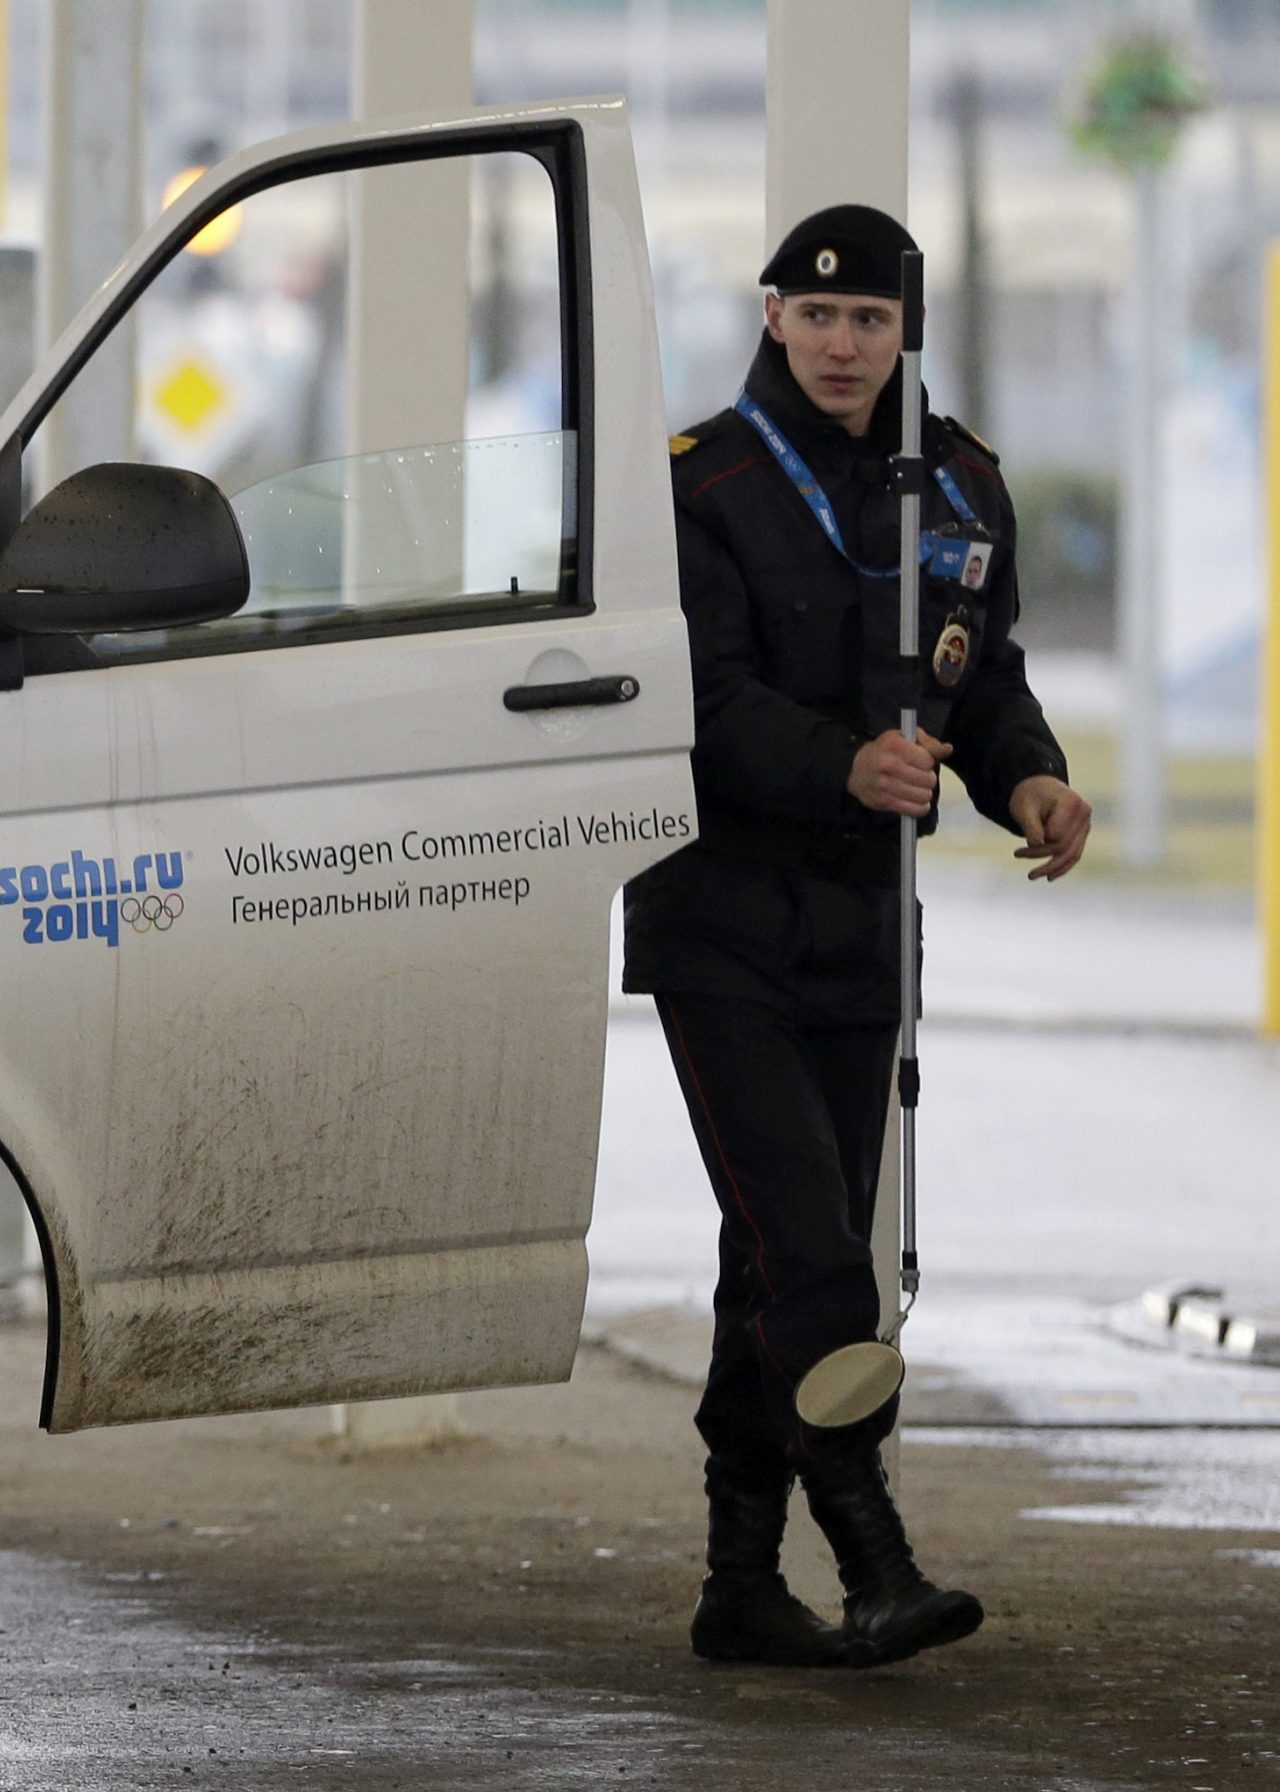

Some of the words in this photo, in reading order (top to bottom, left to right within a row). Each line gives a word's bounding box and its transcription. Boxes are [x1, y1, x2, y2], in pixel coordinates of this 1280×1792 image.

[224, 841, 393, 876] Volkswagen
[401, 817, 570, 861] Commercial
[577, 808, 690, 846] Vehicles
[22, 899, 119, 947] 2014
[232, 880, 410, 926] Генеральный
[419, 876, 531, 911] партнер
